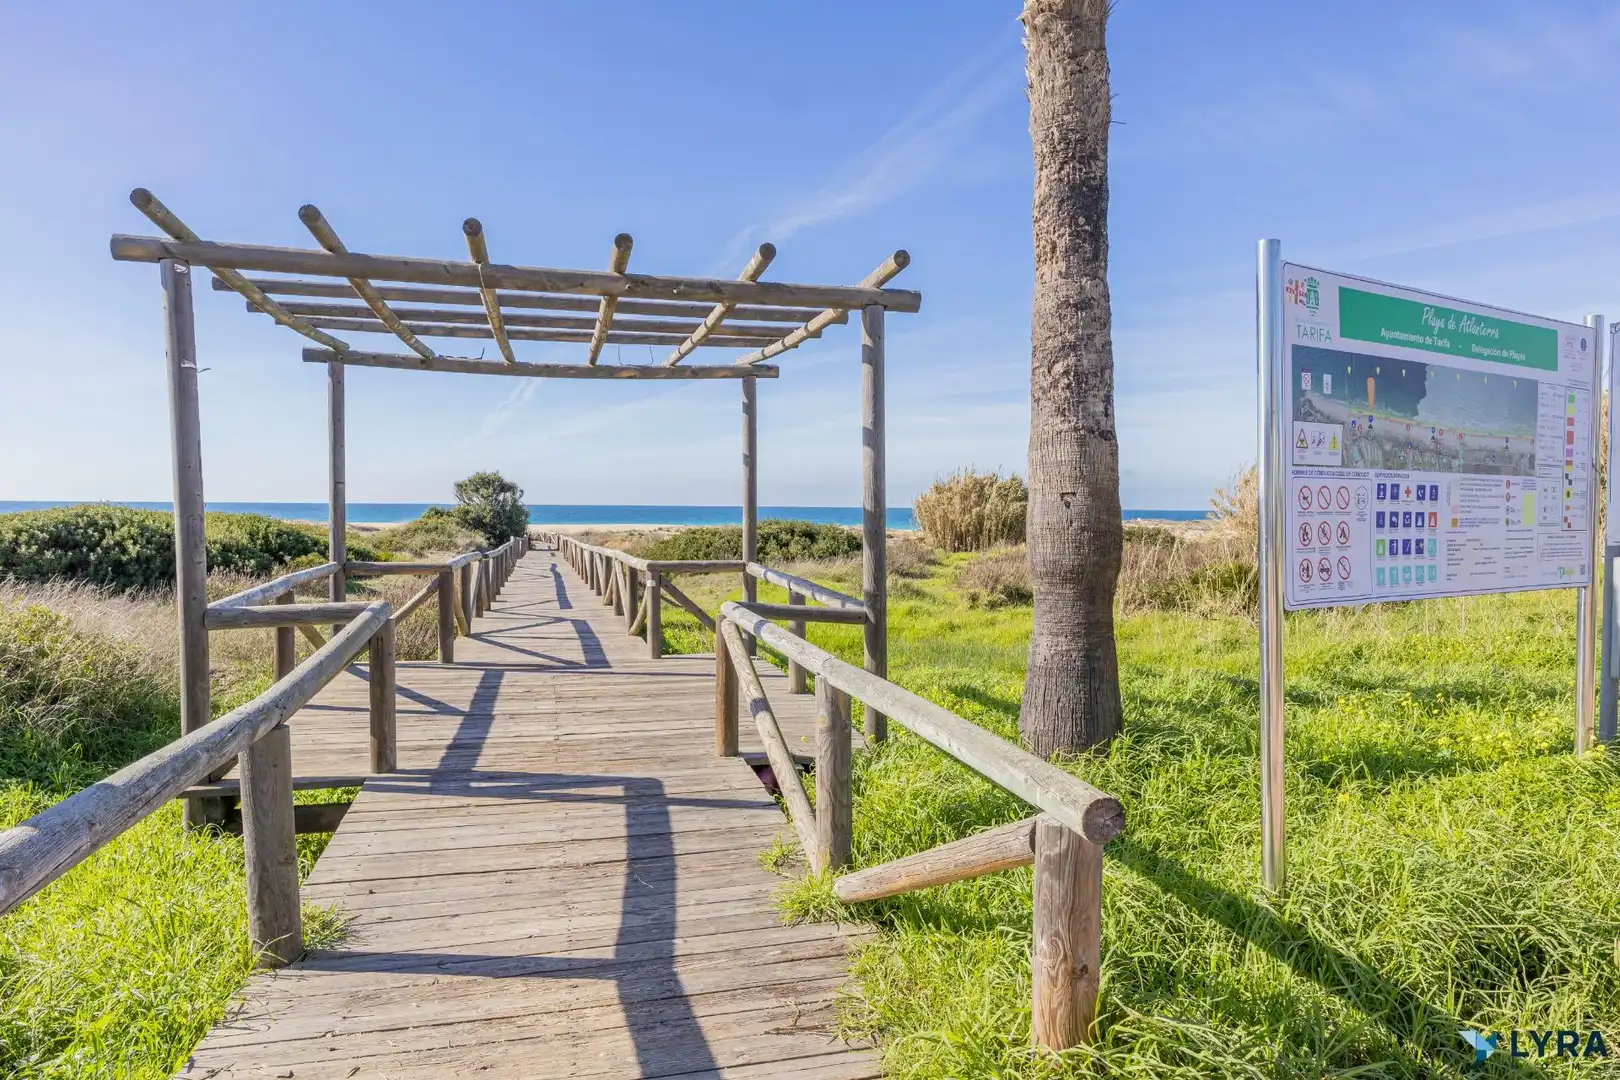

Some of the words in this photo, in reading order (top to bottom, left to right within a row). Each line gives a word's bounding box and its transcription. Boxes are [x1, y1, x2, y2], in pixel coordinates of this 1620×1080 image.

[1421, 306, 1445, 335] Playa
[1447, 313, 1457, 330] de
[1296, 324, 1332, 343] TARIFA
[1380, 327, 1424, 344] Ayuntamiento
[1425, 335, 1433, 345] de
[1433, 336, 1451, 348] Tarifa
